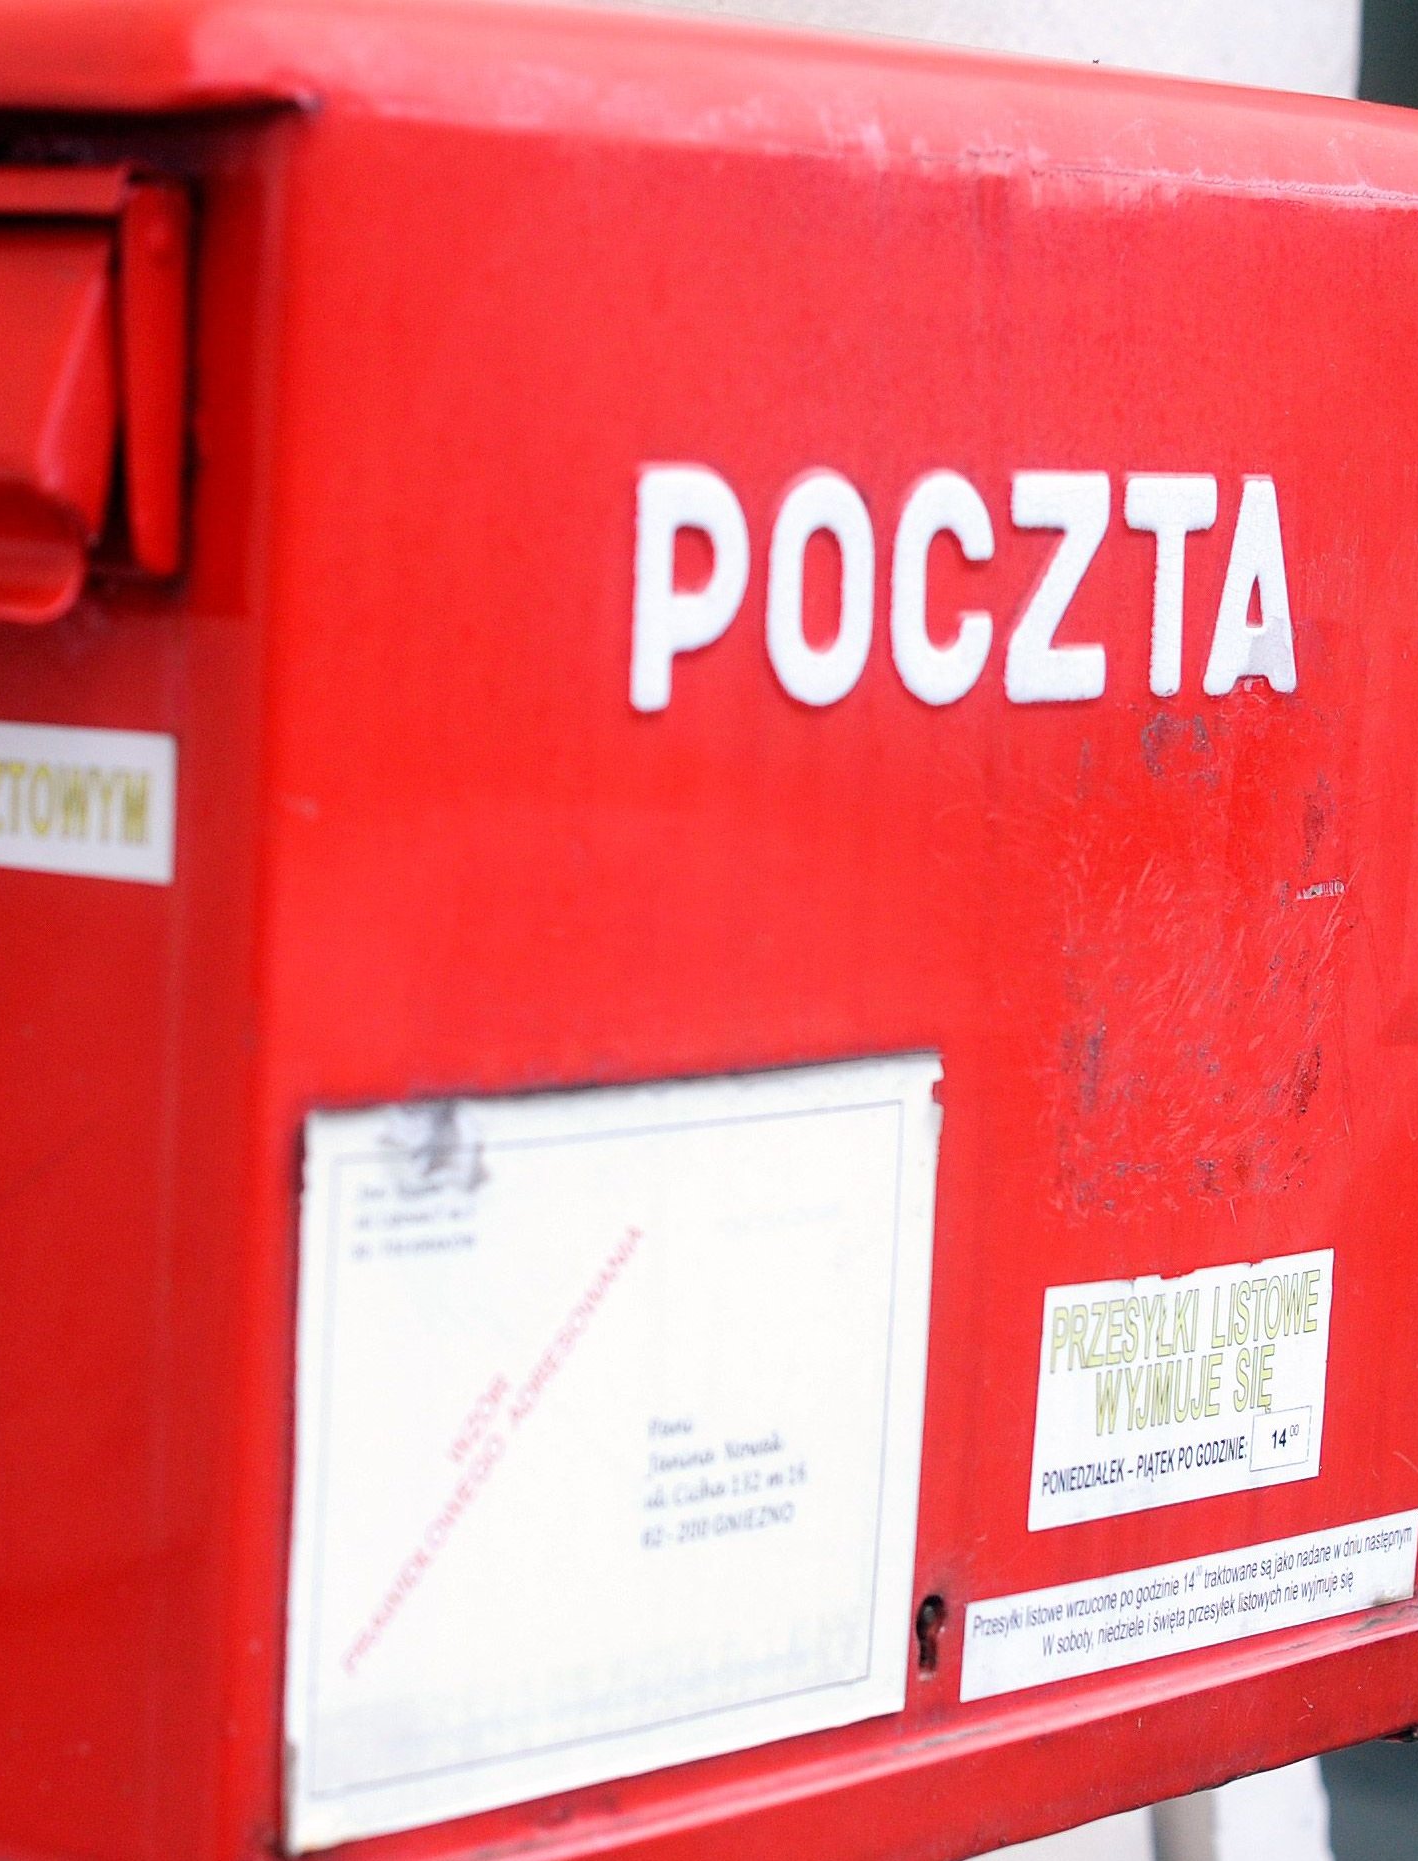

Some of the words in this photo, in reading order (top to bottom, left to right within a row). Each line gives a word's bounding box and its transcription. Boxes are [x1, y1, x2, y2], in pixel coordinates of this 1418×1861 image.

[629, 461, 1298, 711] POCZTA
[1049, 1289, 1199, 1374] PRZESYŁKI
[1211, 1269, 1321, 1349] LISTOWE
[1096, 1353, 1223, 1436] WYJMUJE
[1233, 1344, 1276, 1414] SIĘ
[724, 1429, 784, 1462] Nowak
[1042, 1458, 1125, 1496] PONIEDZIAŁEK
[1136, 1449, 1176, 1483] PIĄTEK
[1177, 1446, 1193, 1470] PO
[1196, 1436, 1248, 1468] GODZINIE:
[712, 1501, 796, 1535] GNIEZNO
[972, 1609, 1023, 1638] Przesyłki
[1026, 1604, 1063, 1627] listowe
[1066, 1596, 1117, 1618] wrzucone
[1119, 1591, 1133, 1612] po
[1135, 1579, 1180, 1610] godzinie
[1204, 1560, 1258, 1589] traktowane
[1260, 1559, 1272, 1579] są
[1272, 1551, 1294, 1579] jako
[1296, 1544, 1331, 1567] nadane
[1333, 1543, 1342, 1559] w
[1343, 1534, 1362, 1557] dniu
[1364, 1526, 1412, 1553] następnym
[1043, 1634, 1056, 1656] W
[1057, 1627, 1094, 1655] soboty,
[1097, 1617, 1144, 1646] niedziele
[1152, 1607, 1186, 1634] święta
[1187, 1594, 1235, 1629] przesyłek
[1237, 1582, 1282, 1613] listowych
[1284, 1579, 1299, 1600] nie
[1301, 1566, 1338, 1602] wyjmuje
[1340, 1567, 1354, 1593] się
